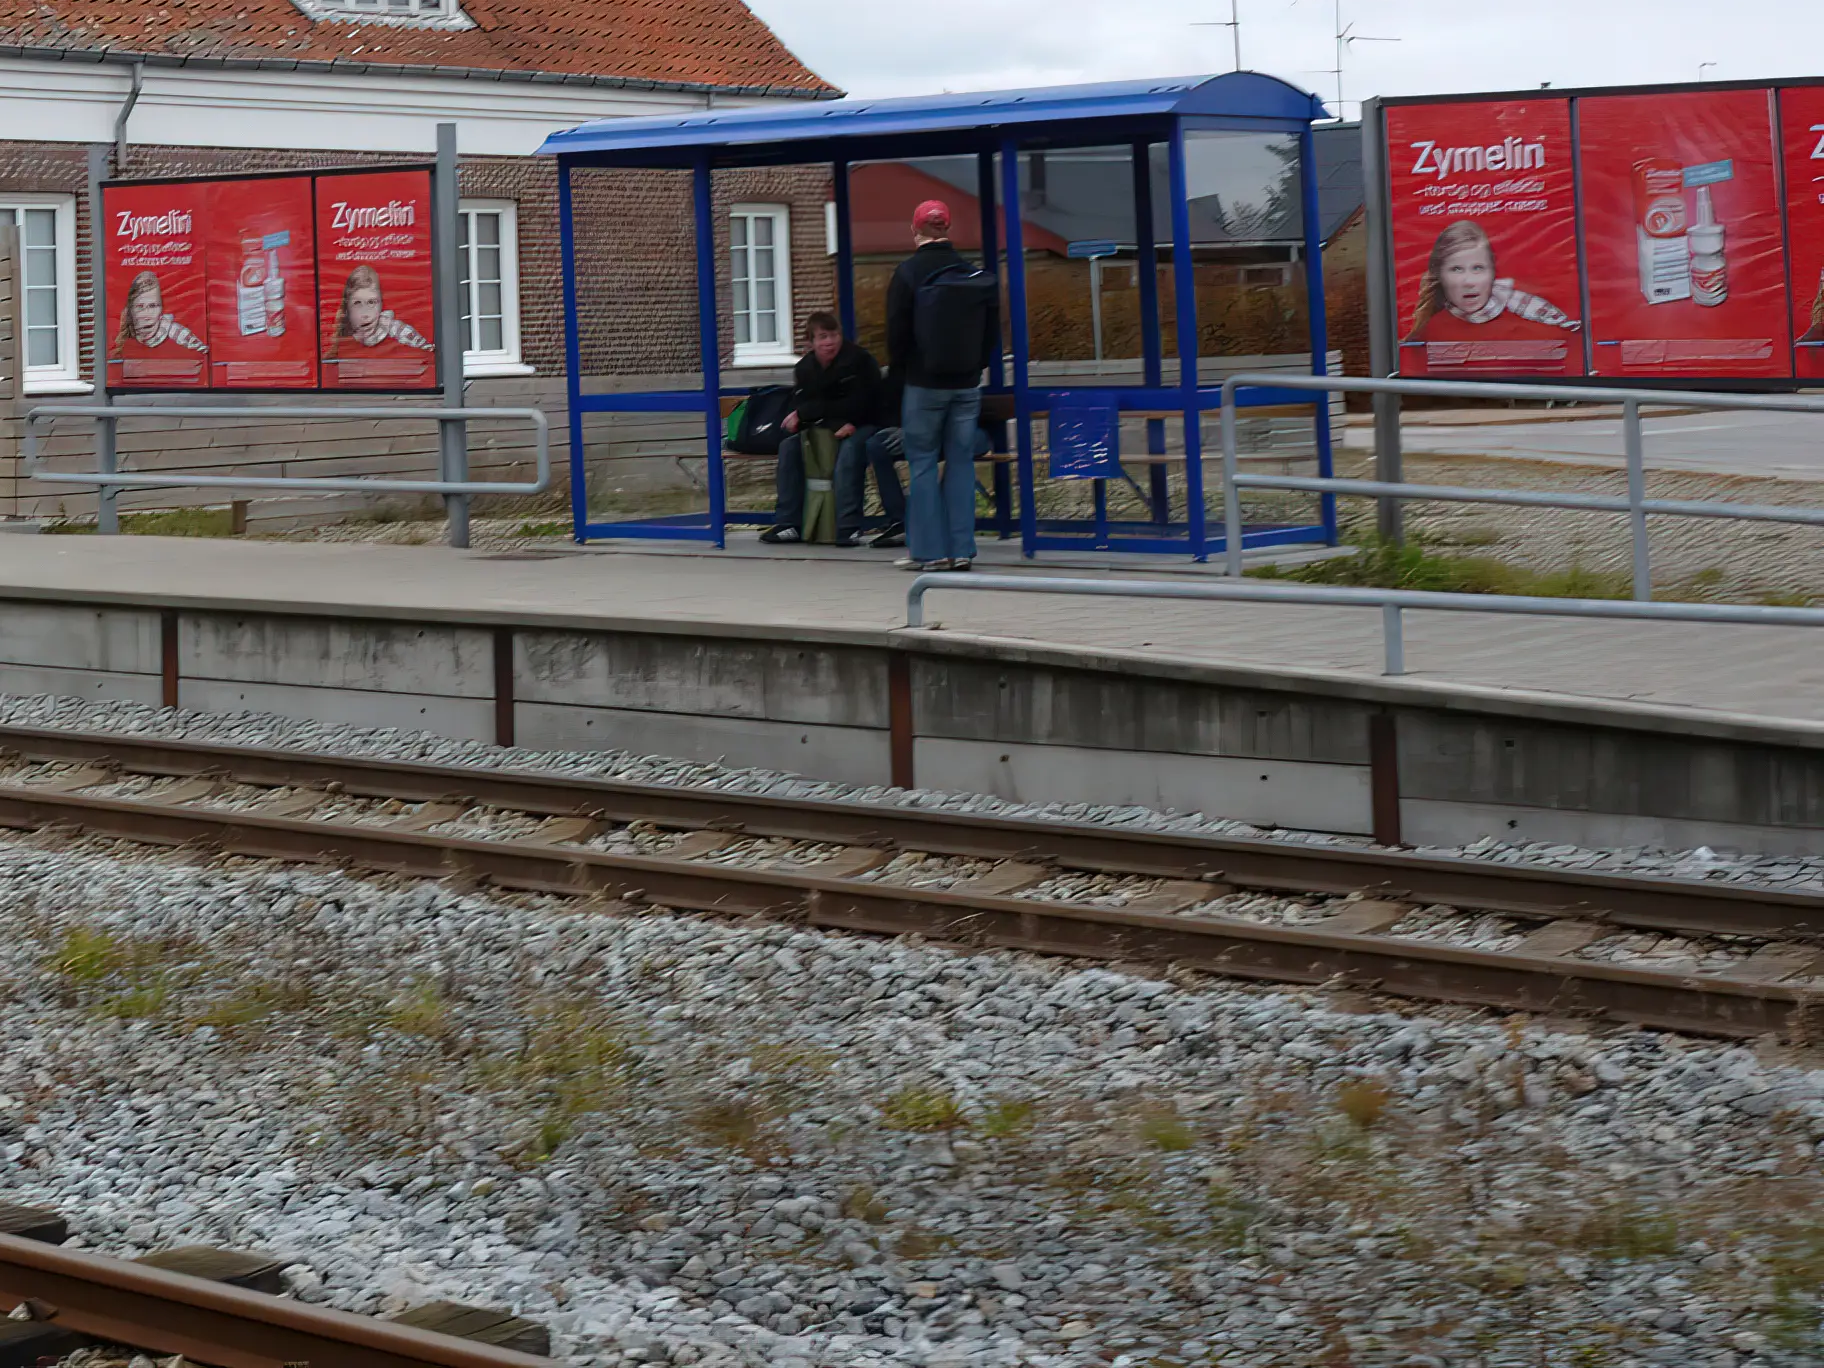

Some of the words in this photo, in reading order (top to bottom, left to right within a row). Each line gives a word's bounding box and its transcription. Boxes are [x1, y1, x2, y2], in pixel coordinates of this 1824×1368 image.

[1410, 135, 1546, 180] Zymelin
[116, 209, 193, 241] Zymelin
[331, 200, 416, 234] Zymelin
